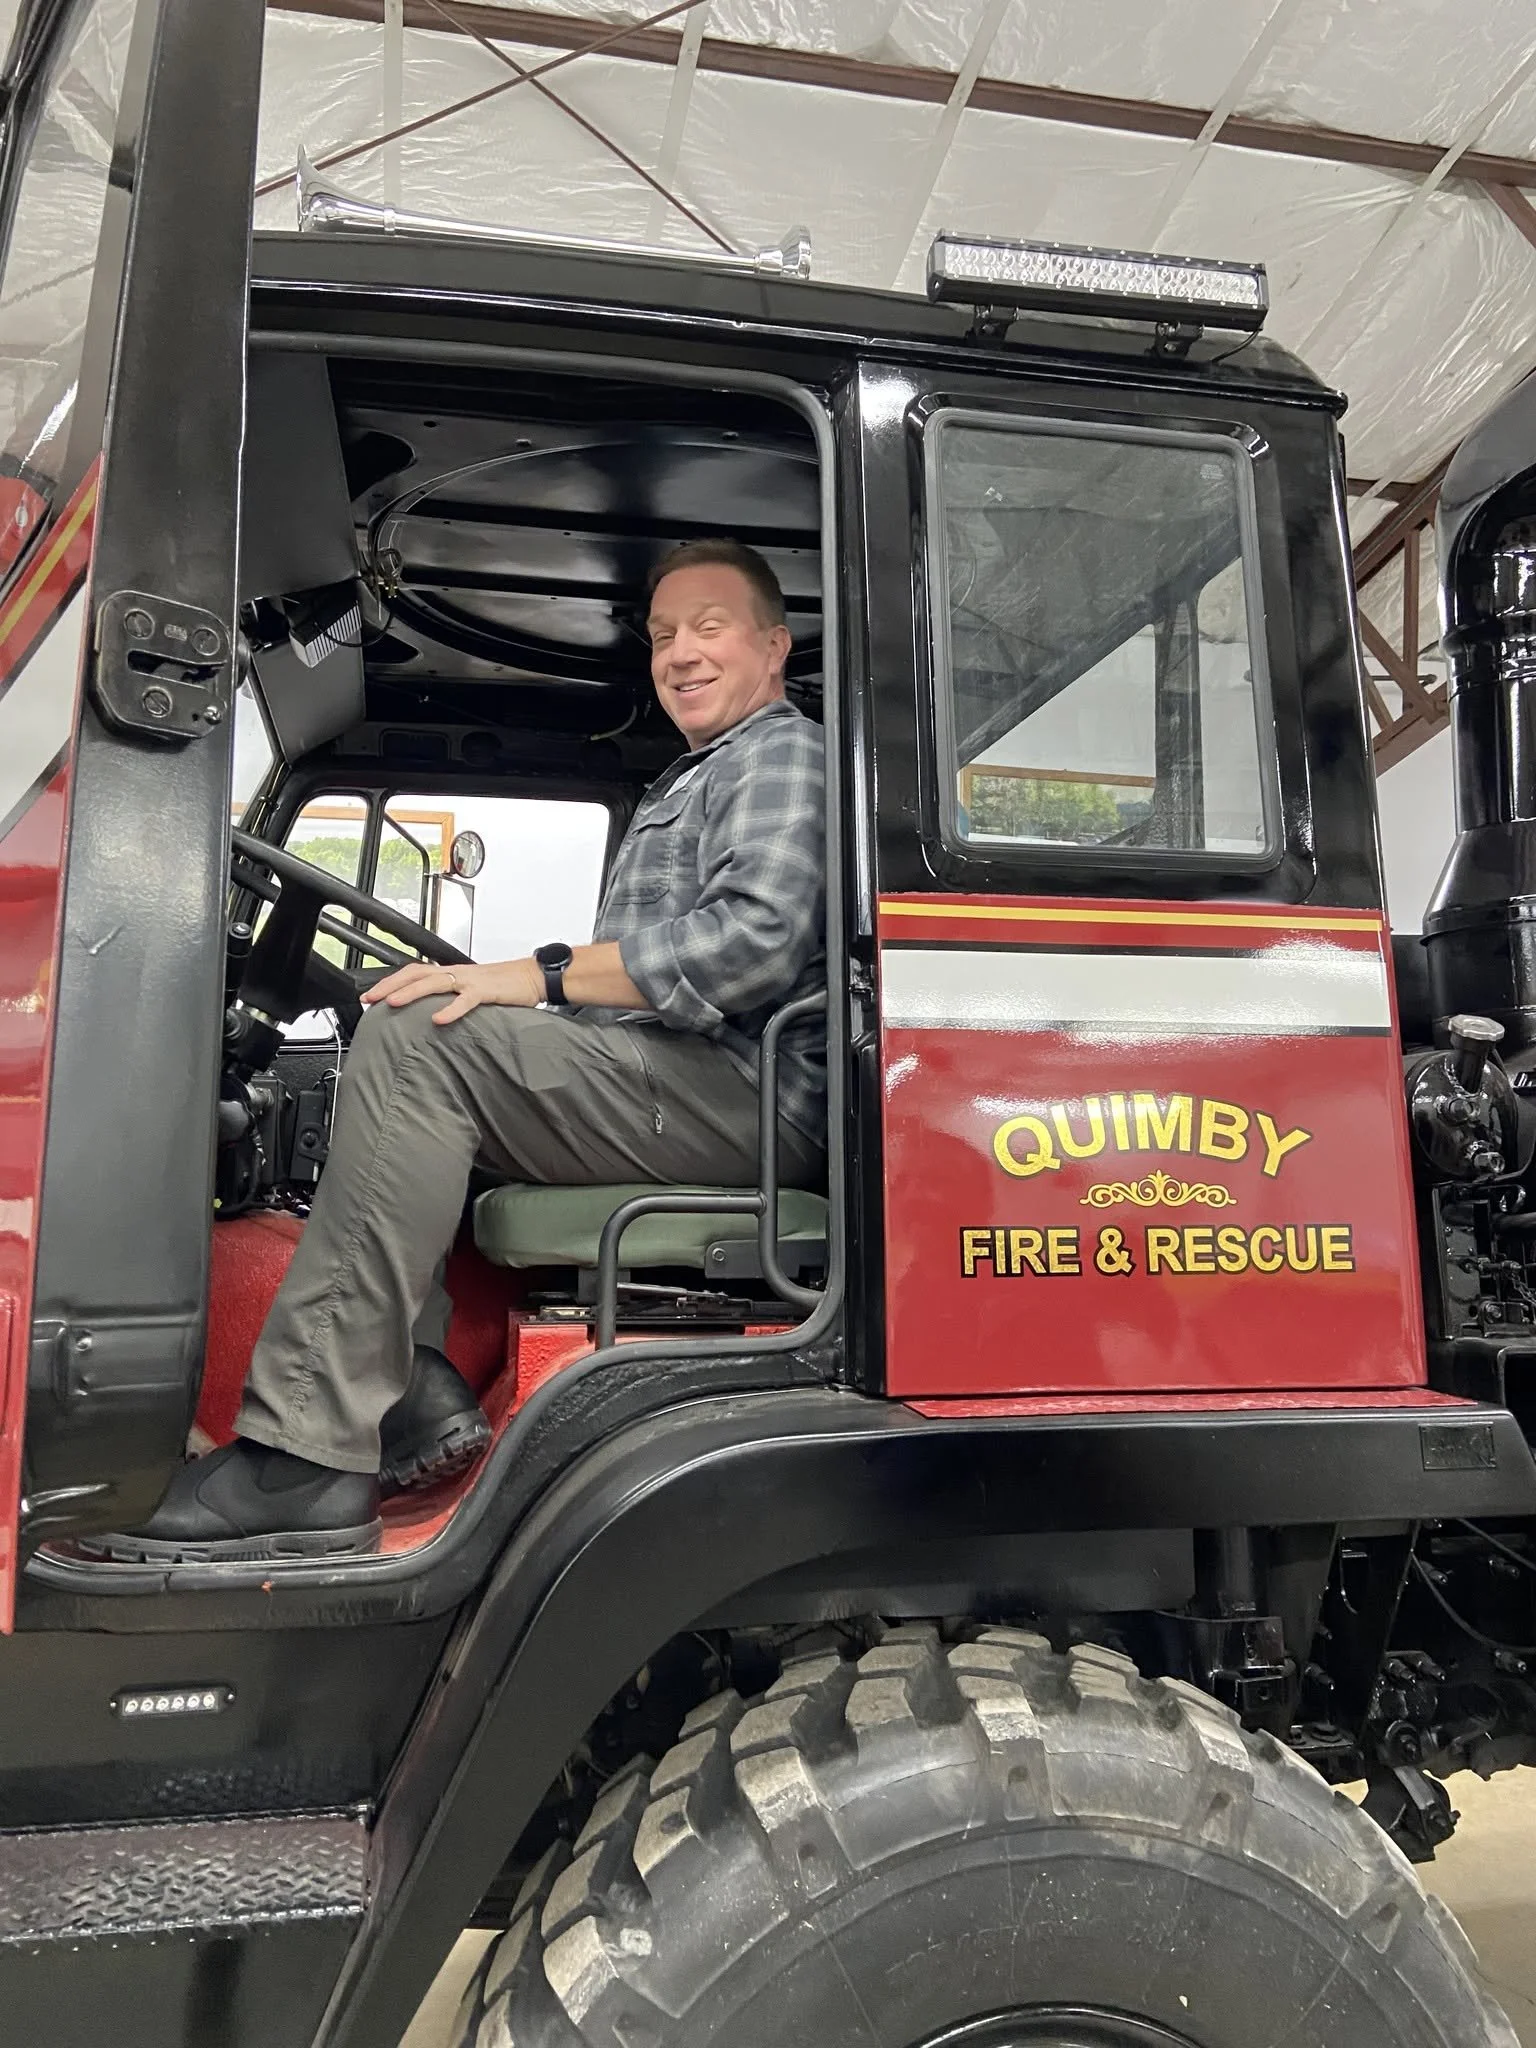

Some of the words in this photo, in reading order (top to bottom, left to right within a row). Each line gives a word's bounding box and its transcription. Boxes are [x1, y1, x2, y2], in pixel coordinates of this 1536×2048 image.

[992, 1091, 1312, 1178] QUIMBY
[961, 1226, 1081, 1276] FIRE
[1095, 1226, 1135, 1276] &
[1147, 1224, 1356, 1273] RESCUE
